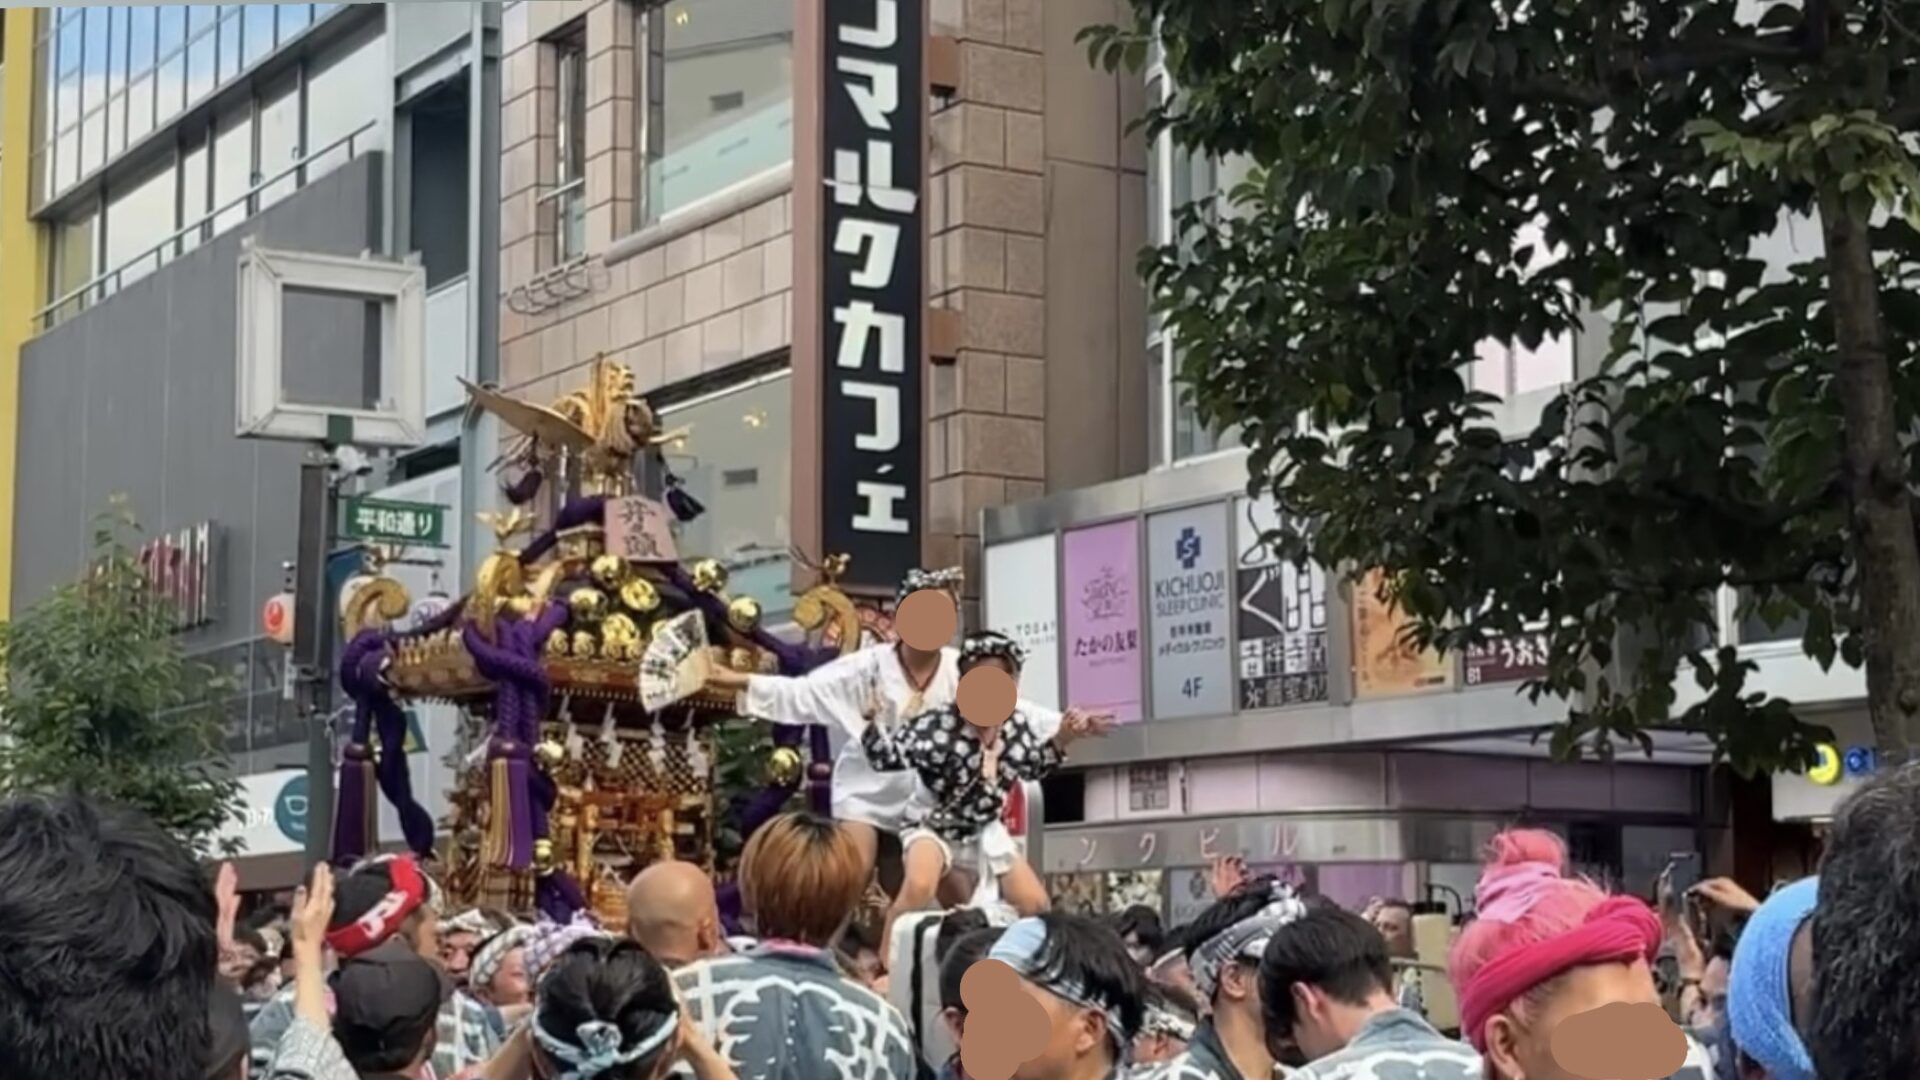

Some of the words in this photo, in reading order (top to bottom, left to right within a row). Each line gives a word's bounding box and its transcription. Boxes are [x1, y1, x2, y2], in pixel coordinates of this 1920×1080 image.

[355, 508, 434, 537] 平和通り
[1154, 571, 1225, 599] KICHIJOJI
[1181, 677, 1204, 699] 4F
